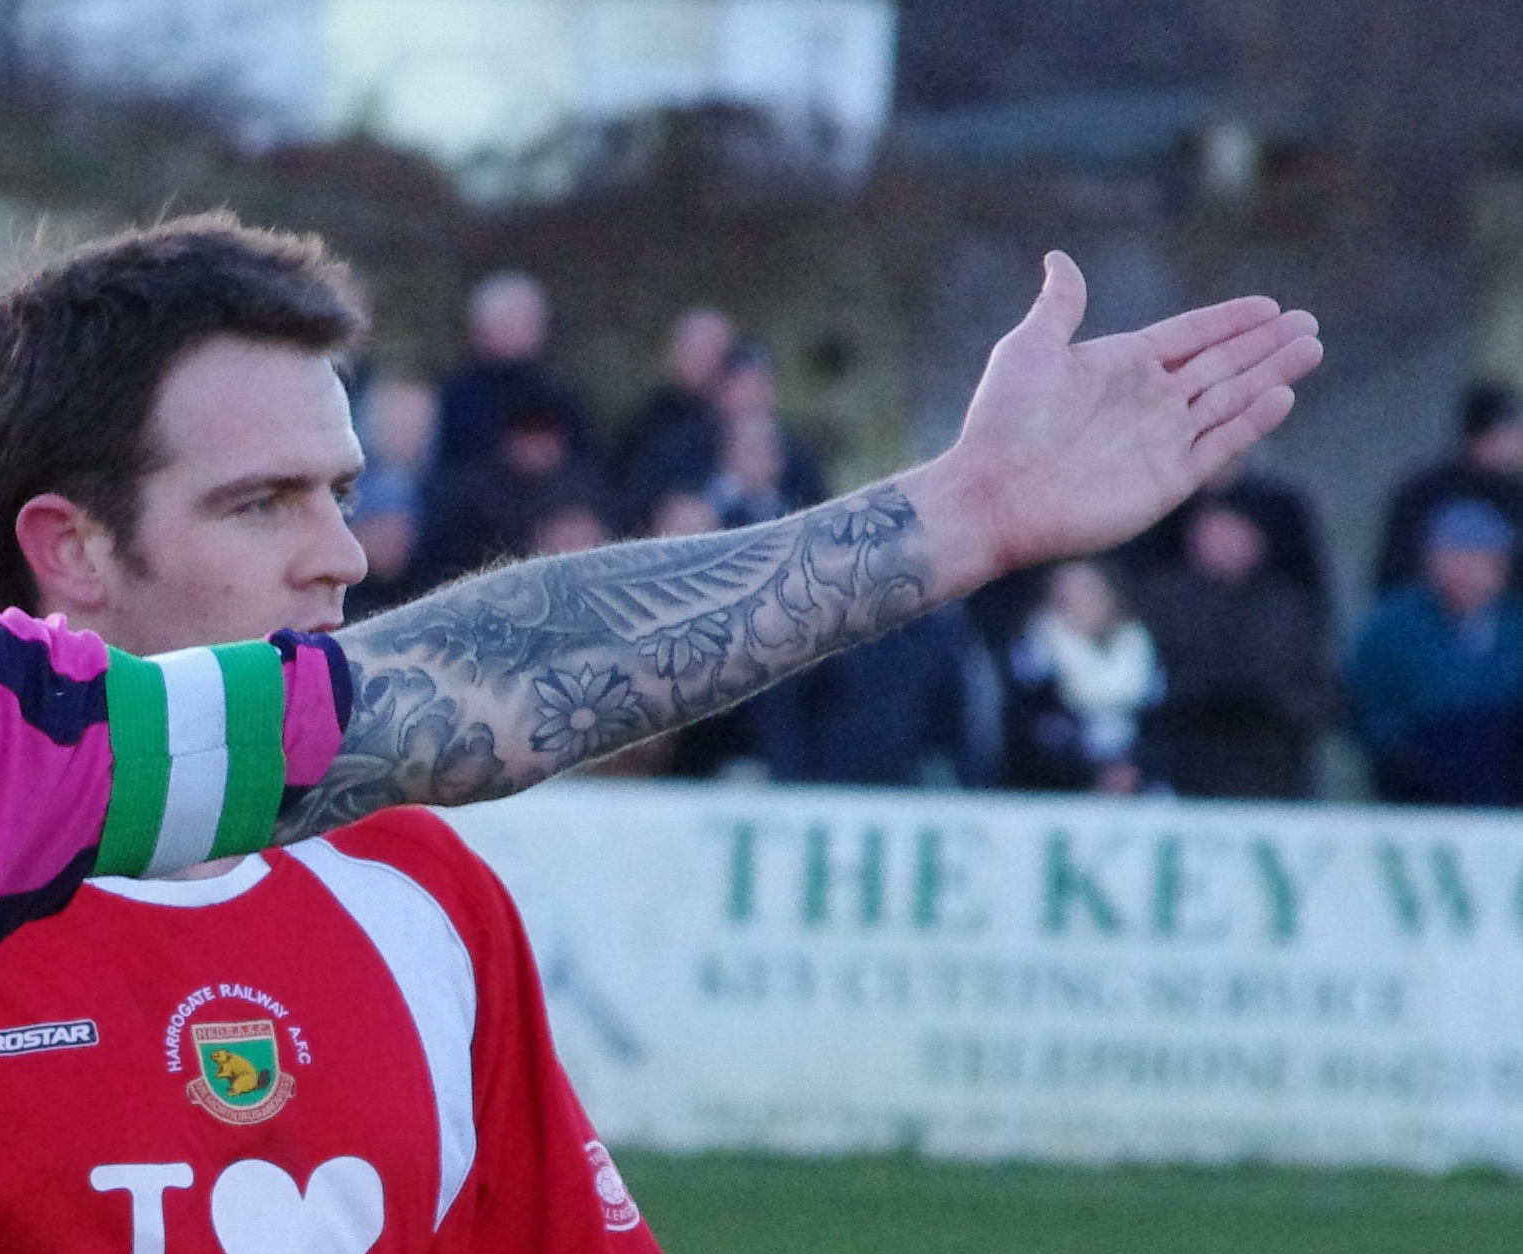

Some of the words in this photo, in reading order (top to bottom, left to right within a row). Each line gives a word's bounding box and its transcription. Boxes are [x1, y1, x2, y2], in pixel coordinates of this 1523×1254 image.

[700, 815, 992, 934] THE
[1042, 823, 1340, 946] KEY
[165, 986, 216, 1072] HARROGATE
[219, 983, 289, 1019] RAILWAY
